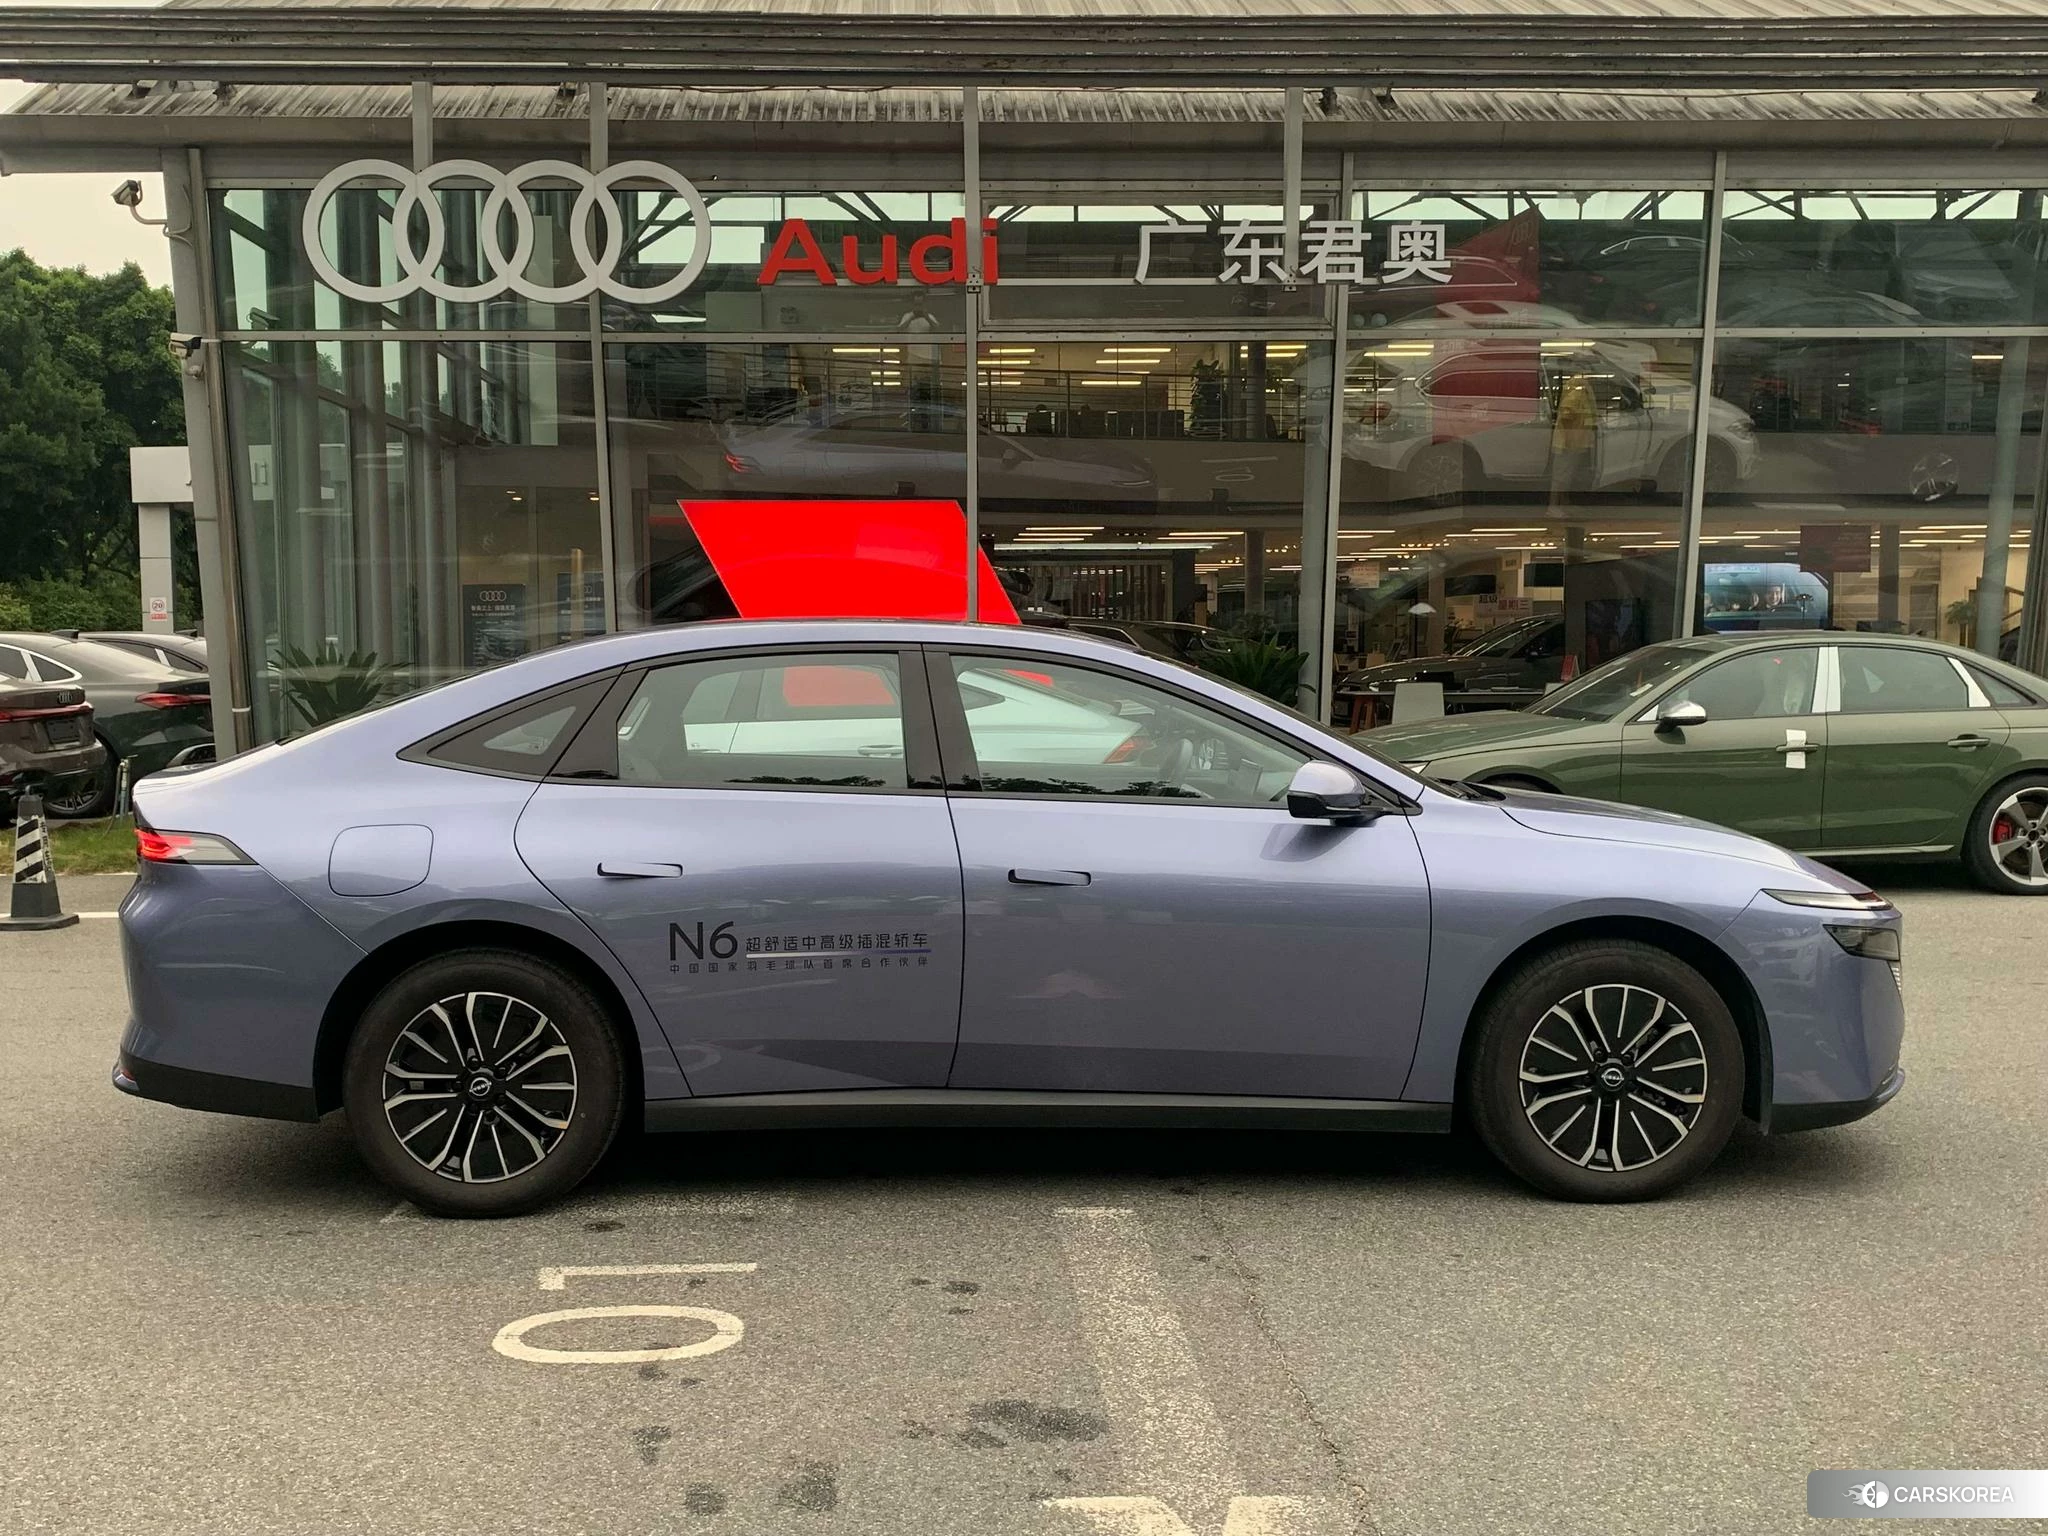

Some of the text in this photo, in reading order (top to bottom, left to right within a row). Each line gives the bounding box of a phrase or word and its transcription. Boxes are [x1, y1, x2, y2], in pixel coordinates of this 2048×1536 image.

[757, 217, 1453, 285] Audi 广东君奥
[670, 921, 928, 961] N6 超舒适中高级插混轿车
[670, 956, 928, 974] 中国国家羽毛球队首席合作伙伴
